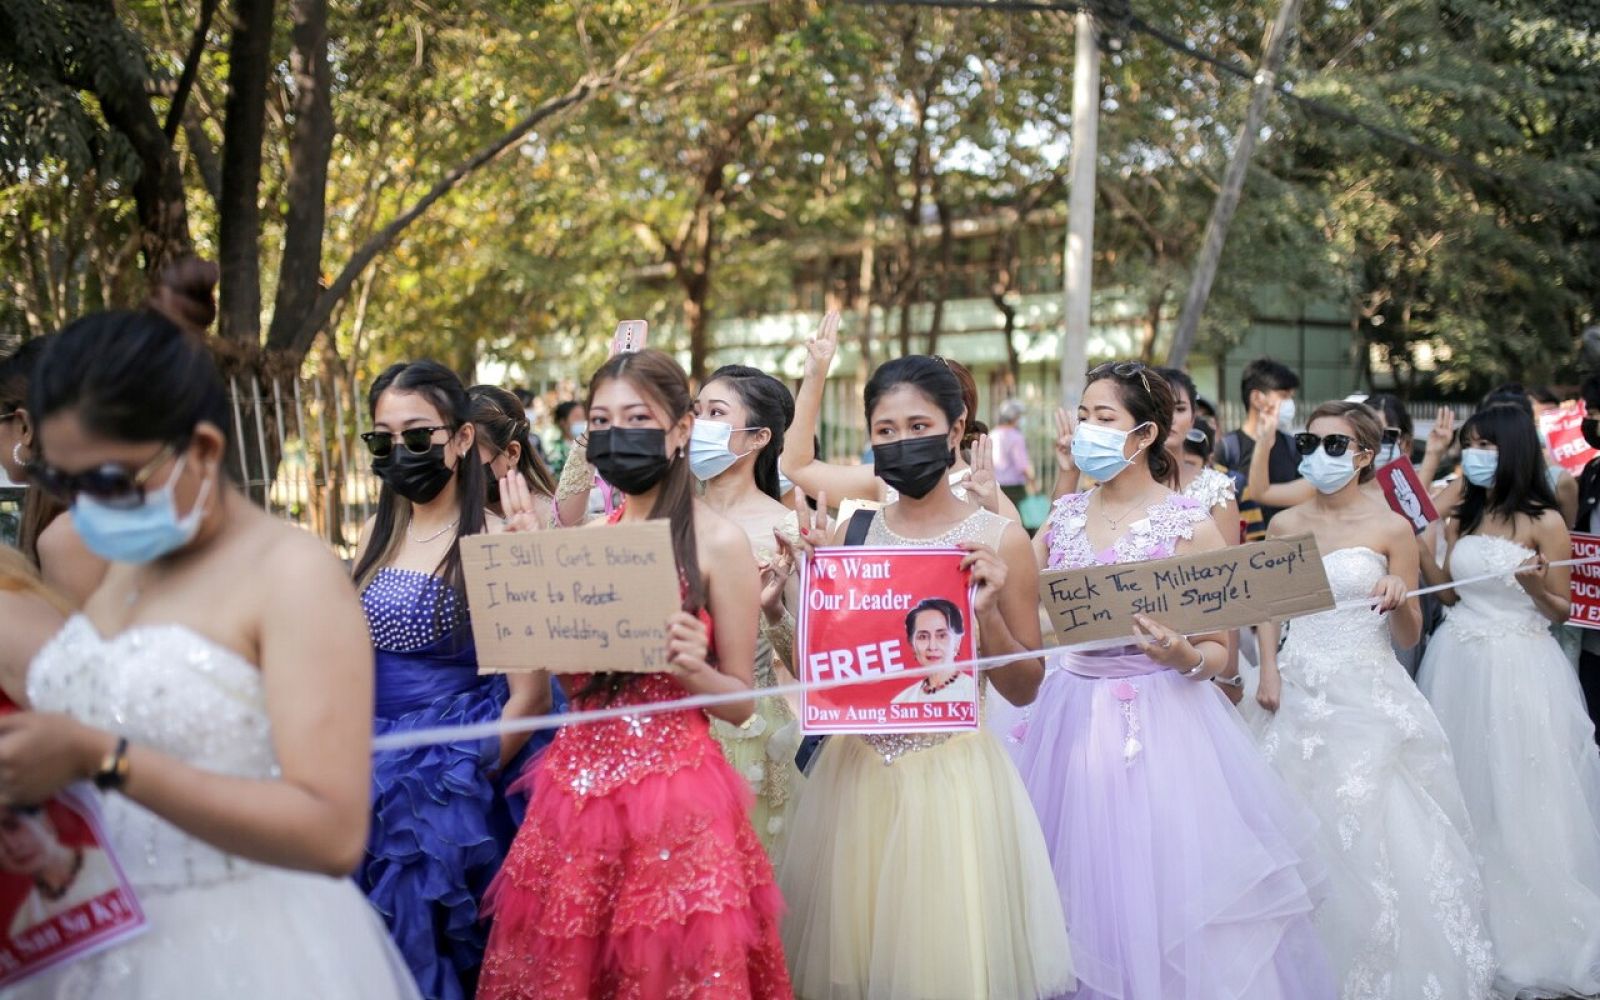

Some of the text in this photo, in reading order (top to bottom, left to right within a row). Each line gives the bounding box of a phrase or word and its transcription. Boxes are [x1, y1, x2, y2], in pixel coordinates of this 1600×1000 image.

[480, 543, 501, 570] I
[510, 543, 544, 567] Still
[812, 557, 891, 580] We Want
[1048, 543, 1306, 604] Fuck The Military Coup!
[486, 581, 501, 609] I
[504, 581, 537, 604] have
[547, 581, 565, 604] to
[809, 588, 912, 611] Our Leader
[1060, 604, 1113, 633] I'm
[1180, 580, 1252, 614] Single!
[495, 622, 512, 641] in
[524, 627, 534, 637] a
[546, 617, 609, 648] Wedding
[809, 639, 905, 684] FREE
[808, 702, 974, 723] Daw Aung San Su Kyi
